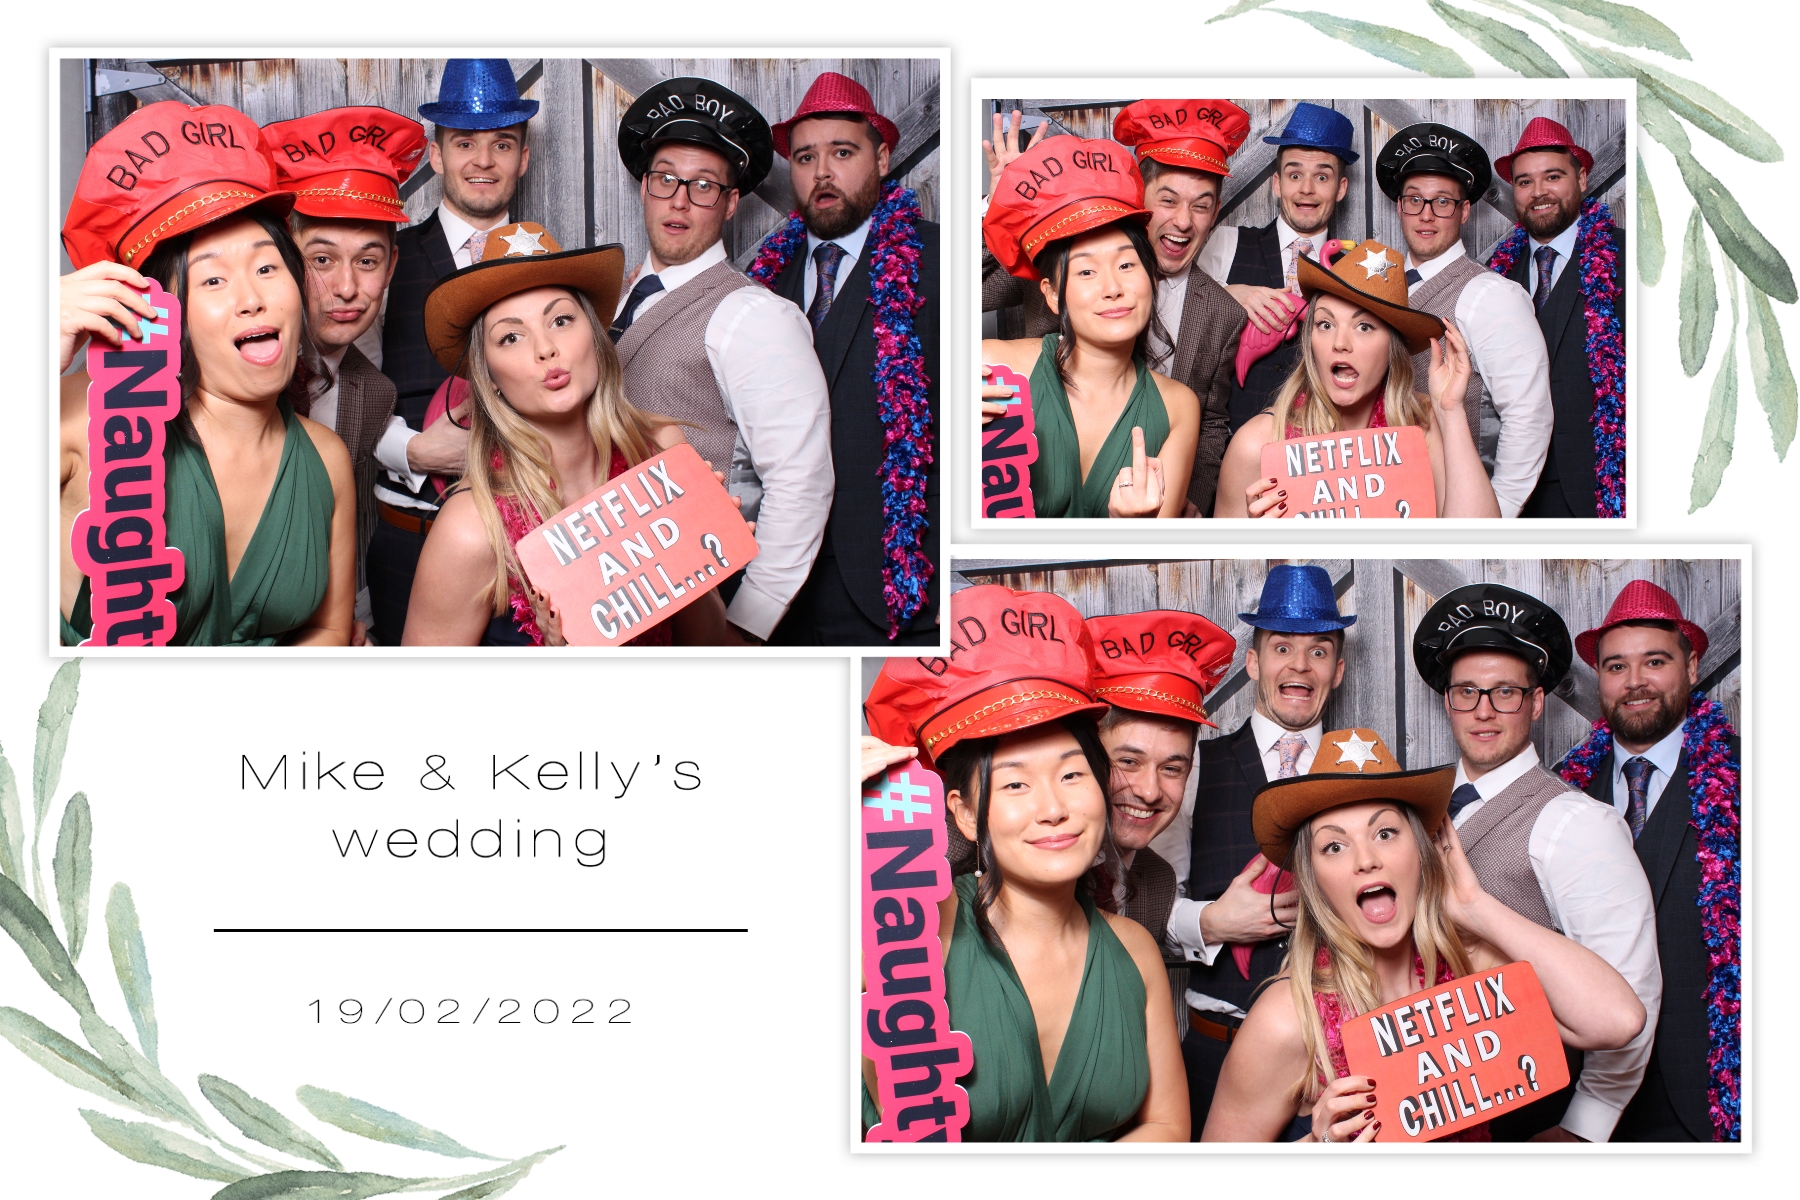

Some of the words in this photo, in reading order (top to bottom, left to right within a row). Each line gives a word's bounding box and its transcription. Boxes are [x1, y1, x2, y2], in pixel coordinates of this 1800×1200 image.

[695, 94, 734, 122] BOY
[1149, 108, 1188, 129] BAD
[1197, 107, 1229, 130] GRL
[106, 130, 170, 191] BAD
[180, 120, 245, 150] GIRL
[281, 131, 336, 163] BAD
[349, 125, 394, 152] GRL
[1429, 134, 1460, 154] BOY
[1015, 156, 1064, 201] BAD
[1072, 150, 1120, 174] GIRL
[86, 293, 173, 646] #Naught
[1285, 431, 1403, 477] NETFLIX
[541, 459, 686, 567] NETFLIX
[1312, 473, 1386, 505] AND
[597, 517, 681, 587] AND
[1483, 600, 1525, 625] BOY
[916, 616, 987, 677] BAD
[1000, 608, 1066, 645] GIRL
[1100, 632, 1155, 660] BAD
[1168, 630, 1209, 662] GRL
[863, 772, 960, 1143] #Naught
[1369, 972, 1516, 1058] NETFLIX
[1417, 1029, 1502, 1086] AND
